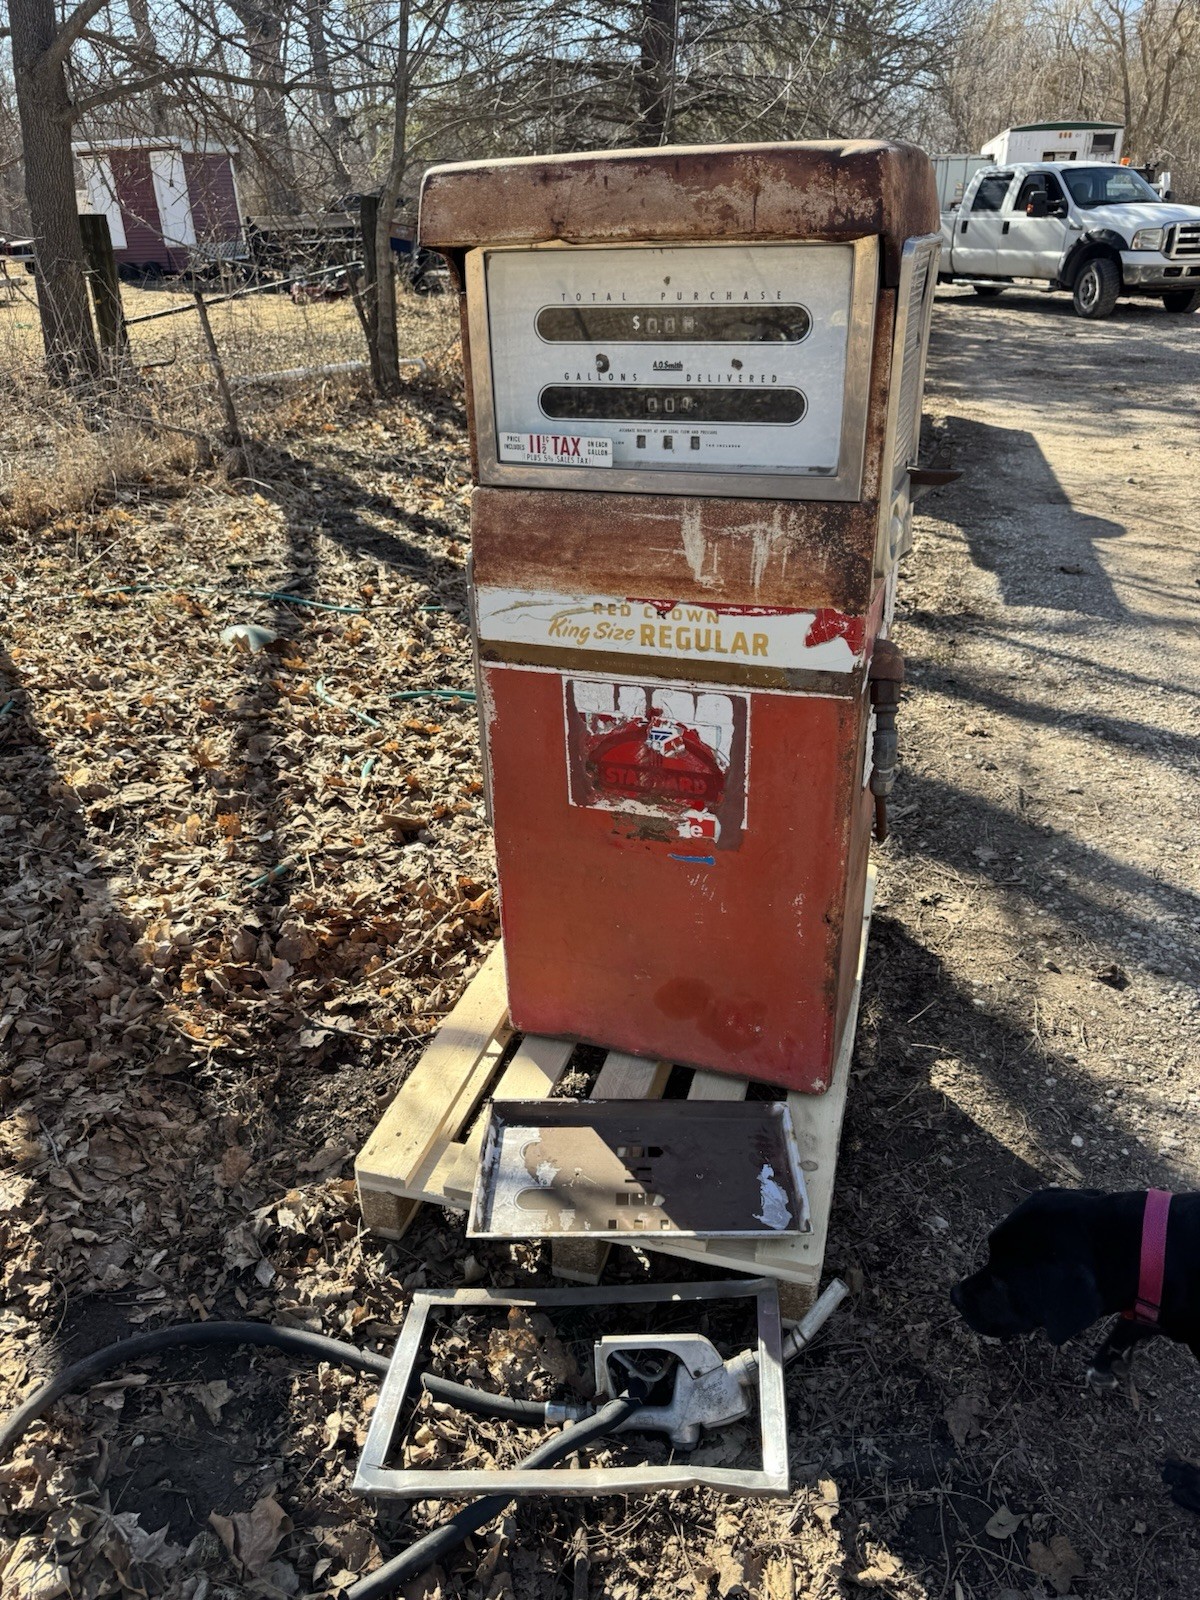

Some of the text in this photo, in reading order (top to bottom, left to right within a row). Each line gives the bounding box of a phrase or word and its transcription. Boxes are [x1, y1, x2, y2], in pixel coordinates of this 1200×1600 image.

[561, 290, 782, 302] TOTAL PURCHASE
[564, 372, 778, 383] GALLONS DELIVERED
[506, 435, 521, 443] PRICE
[503, 443, 526, 452] INCLUDES
[551, 436, 581, 457] TAX
[587, 440, 609, 449] ON EACH
[587, 448, 609, 457] GALLON
[556, 455, 575, 464] SALES
[592, 602, 720, 625] RED COWN
[548, 617, 770, 657] King Size REGULAR
